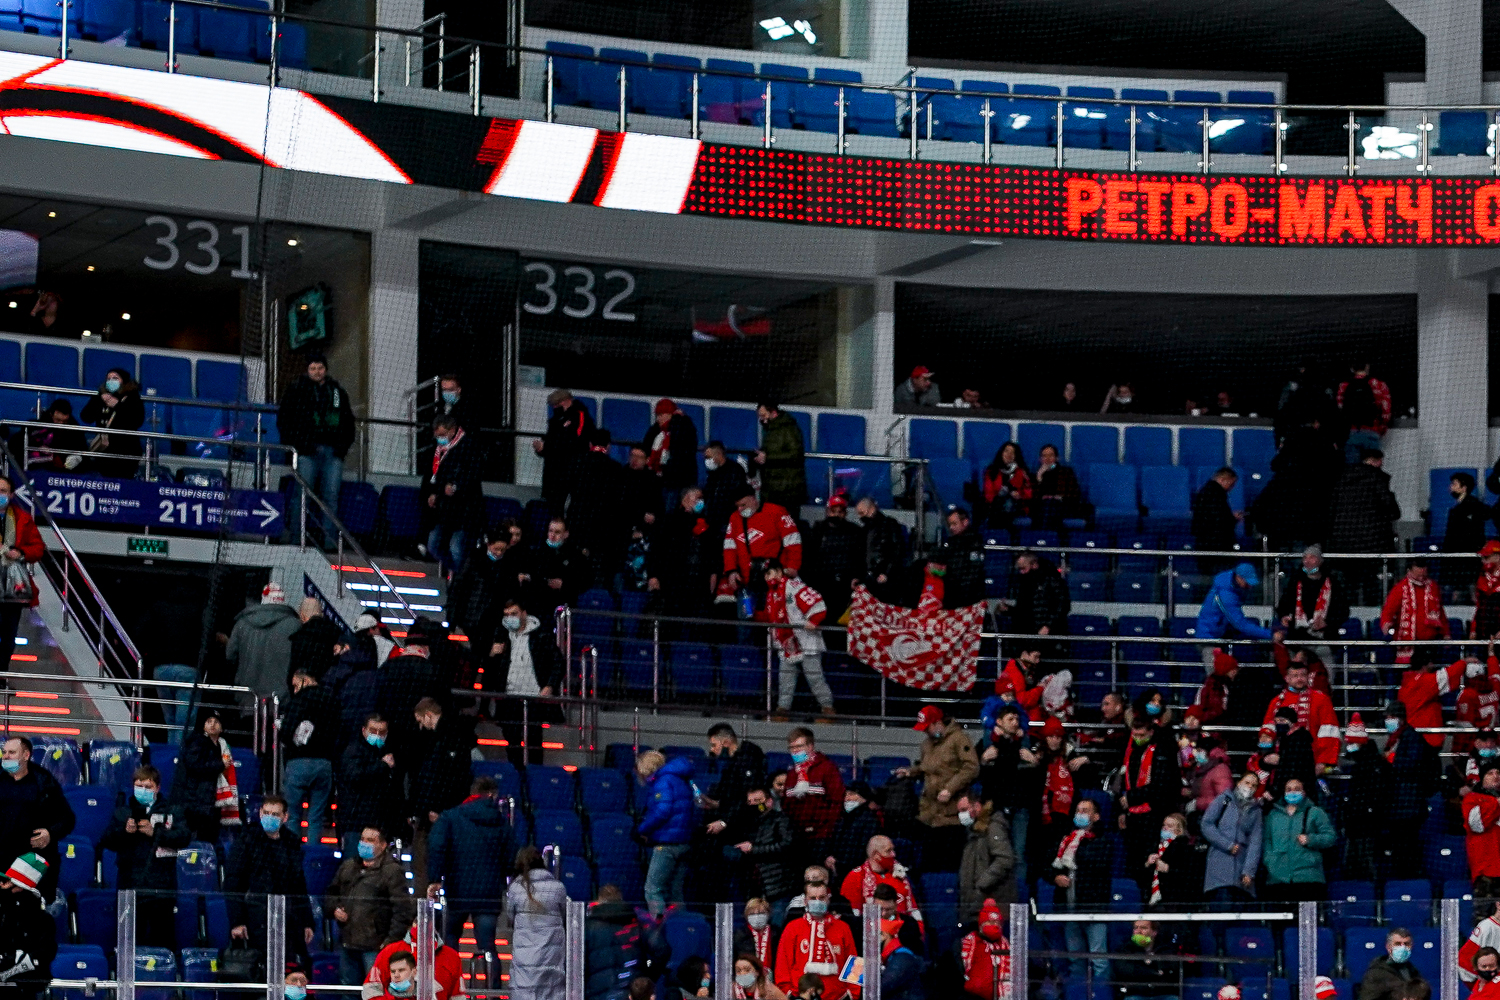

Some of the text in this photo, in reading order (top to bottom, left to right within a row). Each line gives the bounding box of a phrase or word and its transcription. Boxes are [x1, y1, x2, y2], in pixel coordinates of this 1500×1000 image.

[1067, 177, 1433, 240] РЕТРО-МАТЧ
[143, 215, 258, 279] 331
[523, 262, 637, 322] 332
[47, 491, 96, 517] 210
[158, 500, 204, 526] 211
